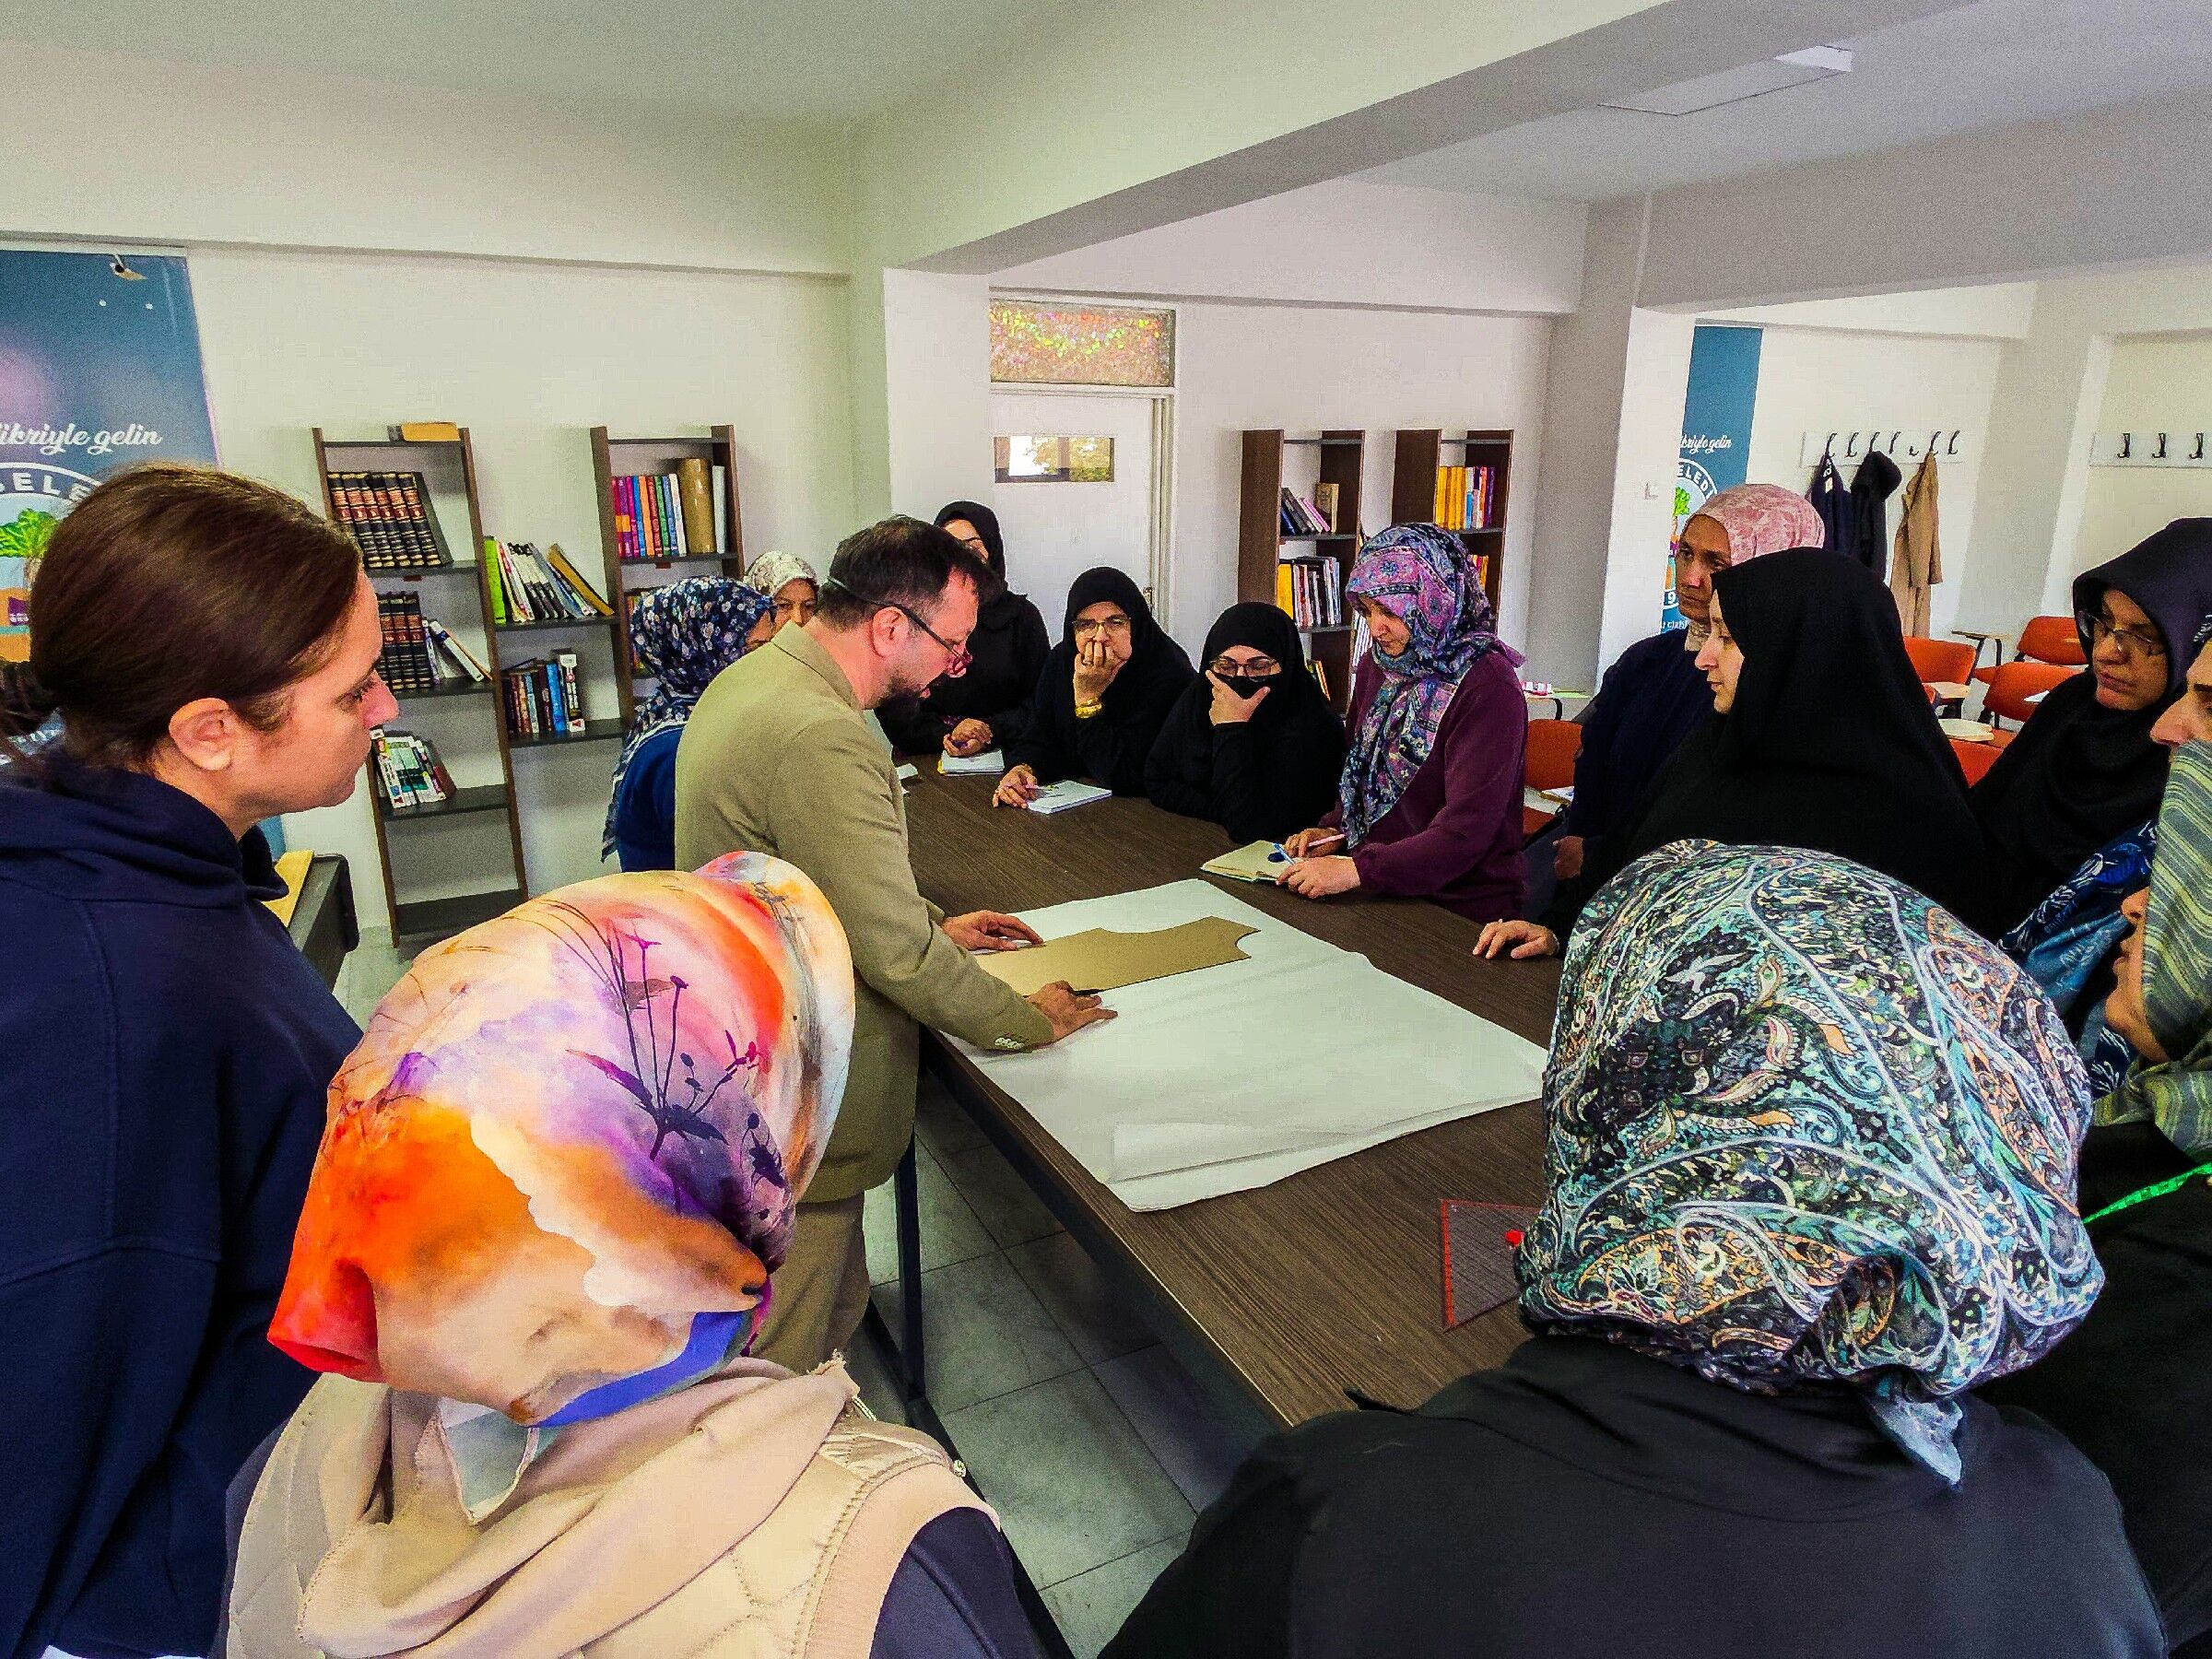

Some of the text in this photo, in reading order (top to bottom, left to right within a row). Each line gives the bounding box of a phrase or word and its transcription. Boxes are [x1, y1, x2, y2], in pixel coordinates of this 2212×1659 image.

[0, 423, 163, 455] ikriyle gelin
[1705, 434, 1732, 454] gelin
